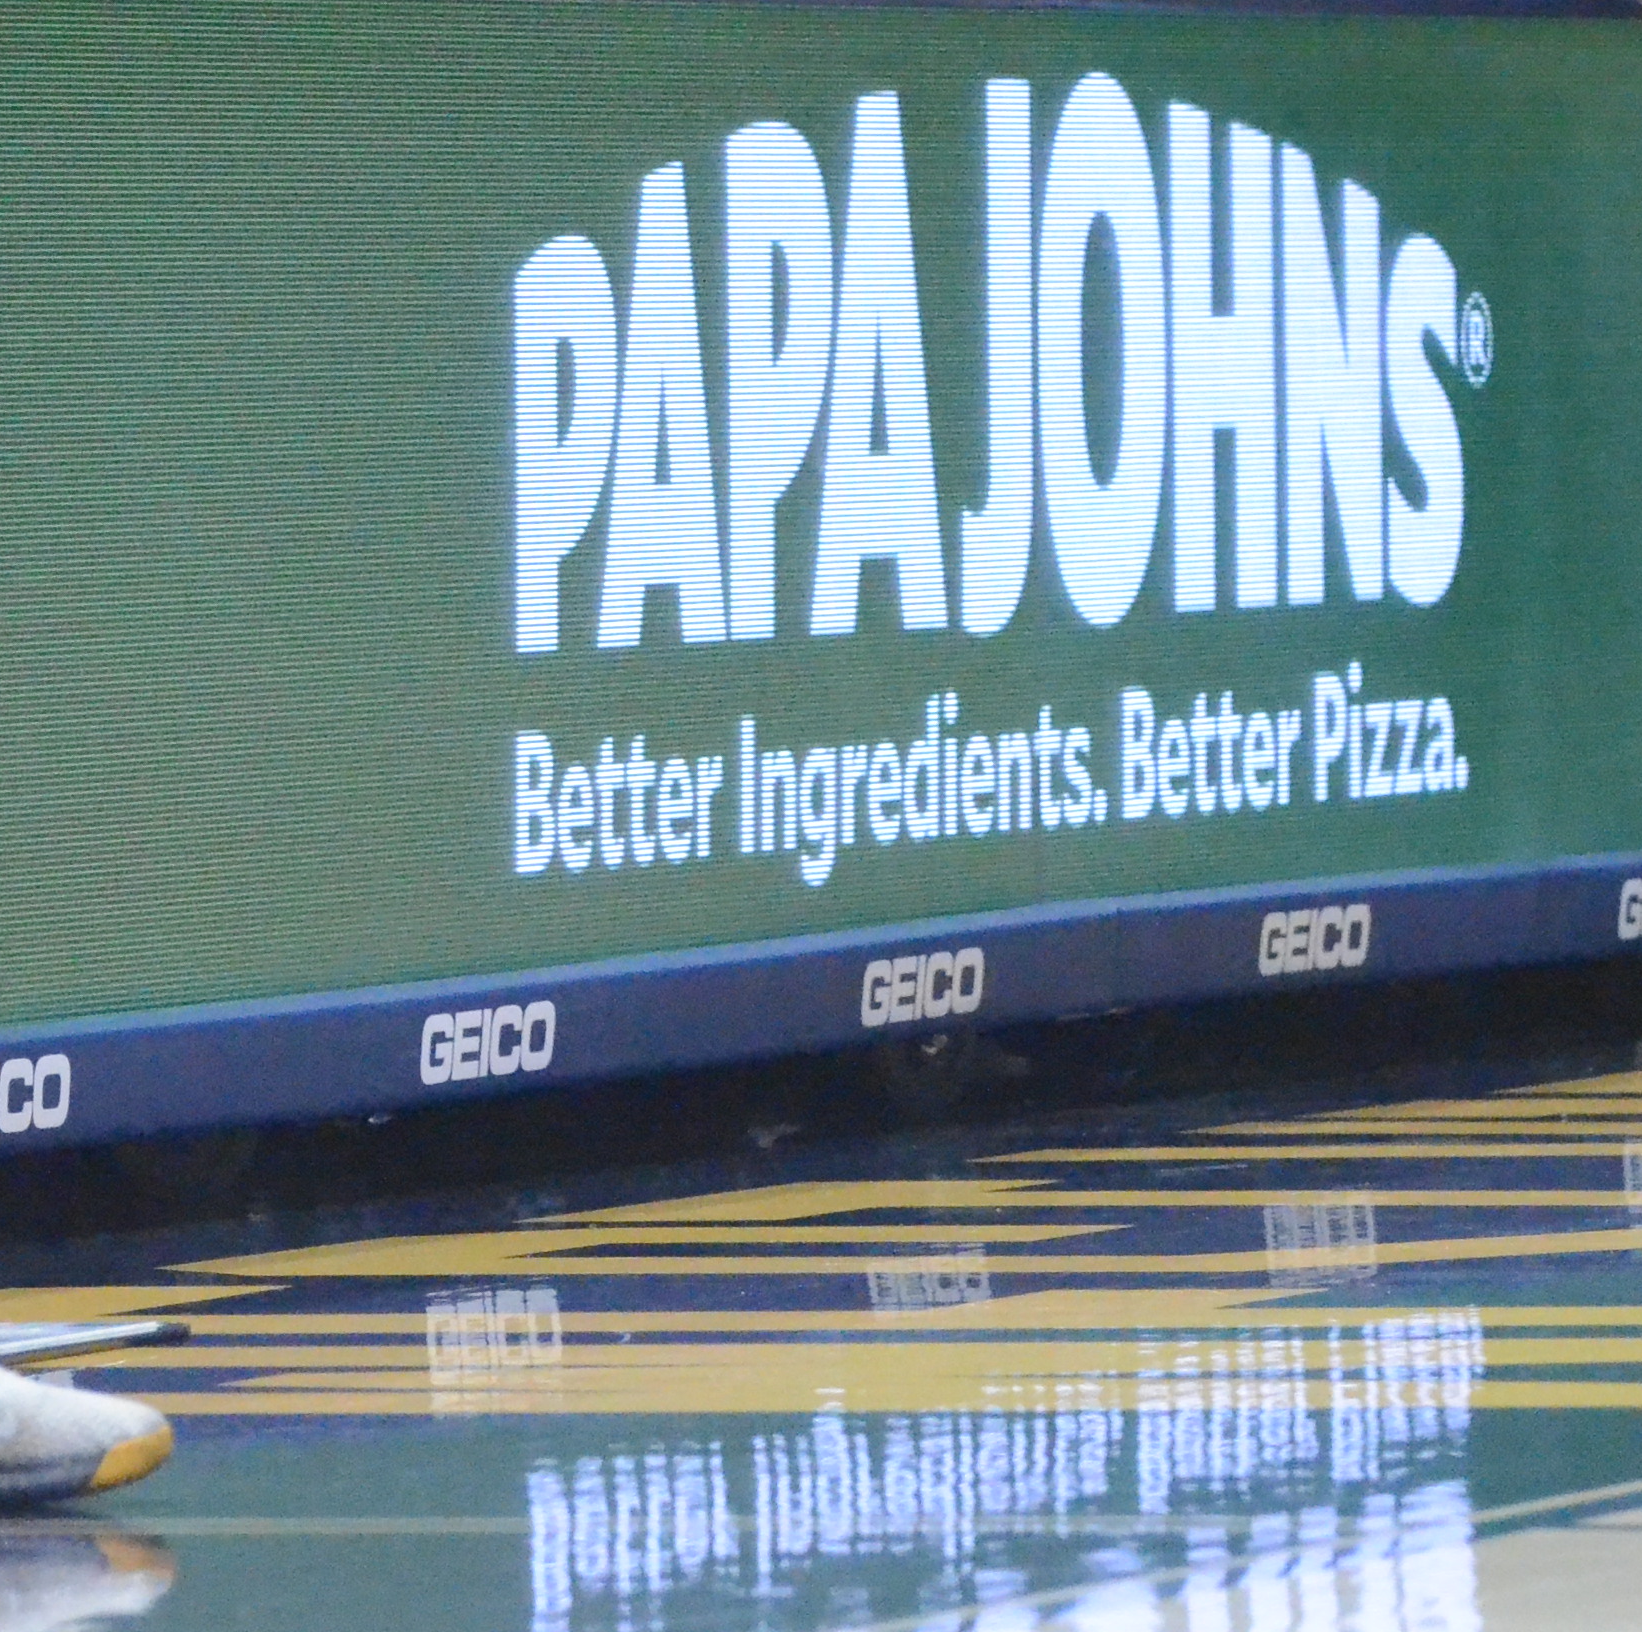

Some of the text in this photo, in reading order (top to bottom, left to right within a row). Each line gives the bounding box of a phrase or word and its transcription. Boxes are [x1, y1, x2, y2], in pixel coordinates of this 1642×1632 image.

[513, 660, 1471, 888] Better Ingredients. Better Pizza.
[1258, 903, 1372, 976] GEICO
[860, 946, 985, 1027] GEICO
[419, 999, 557, 1085] GEICO
